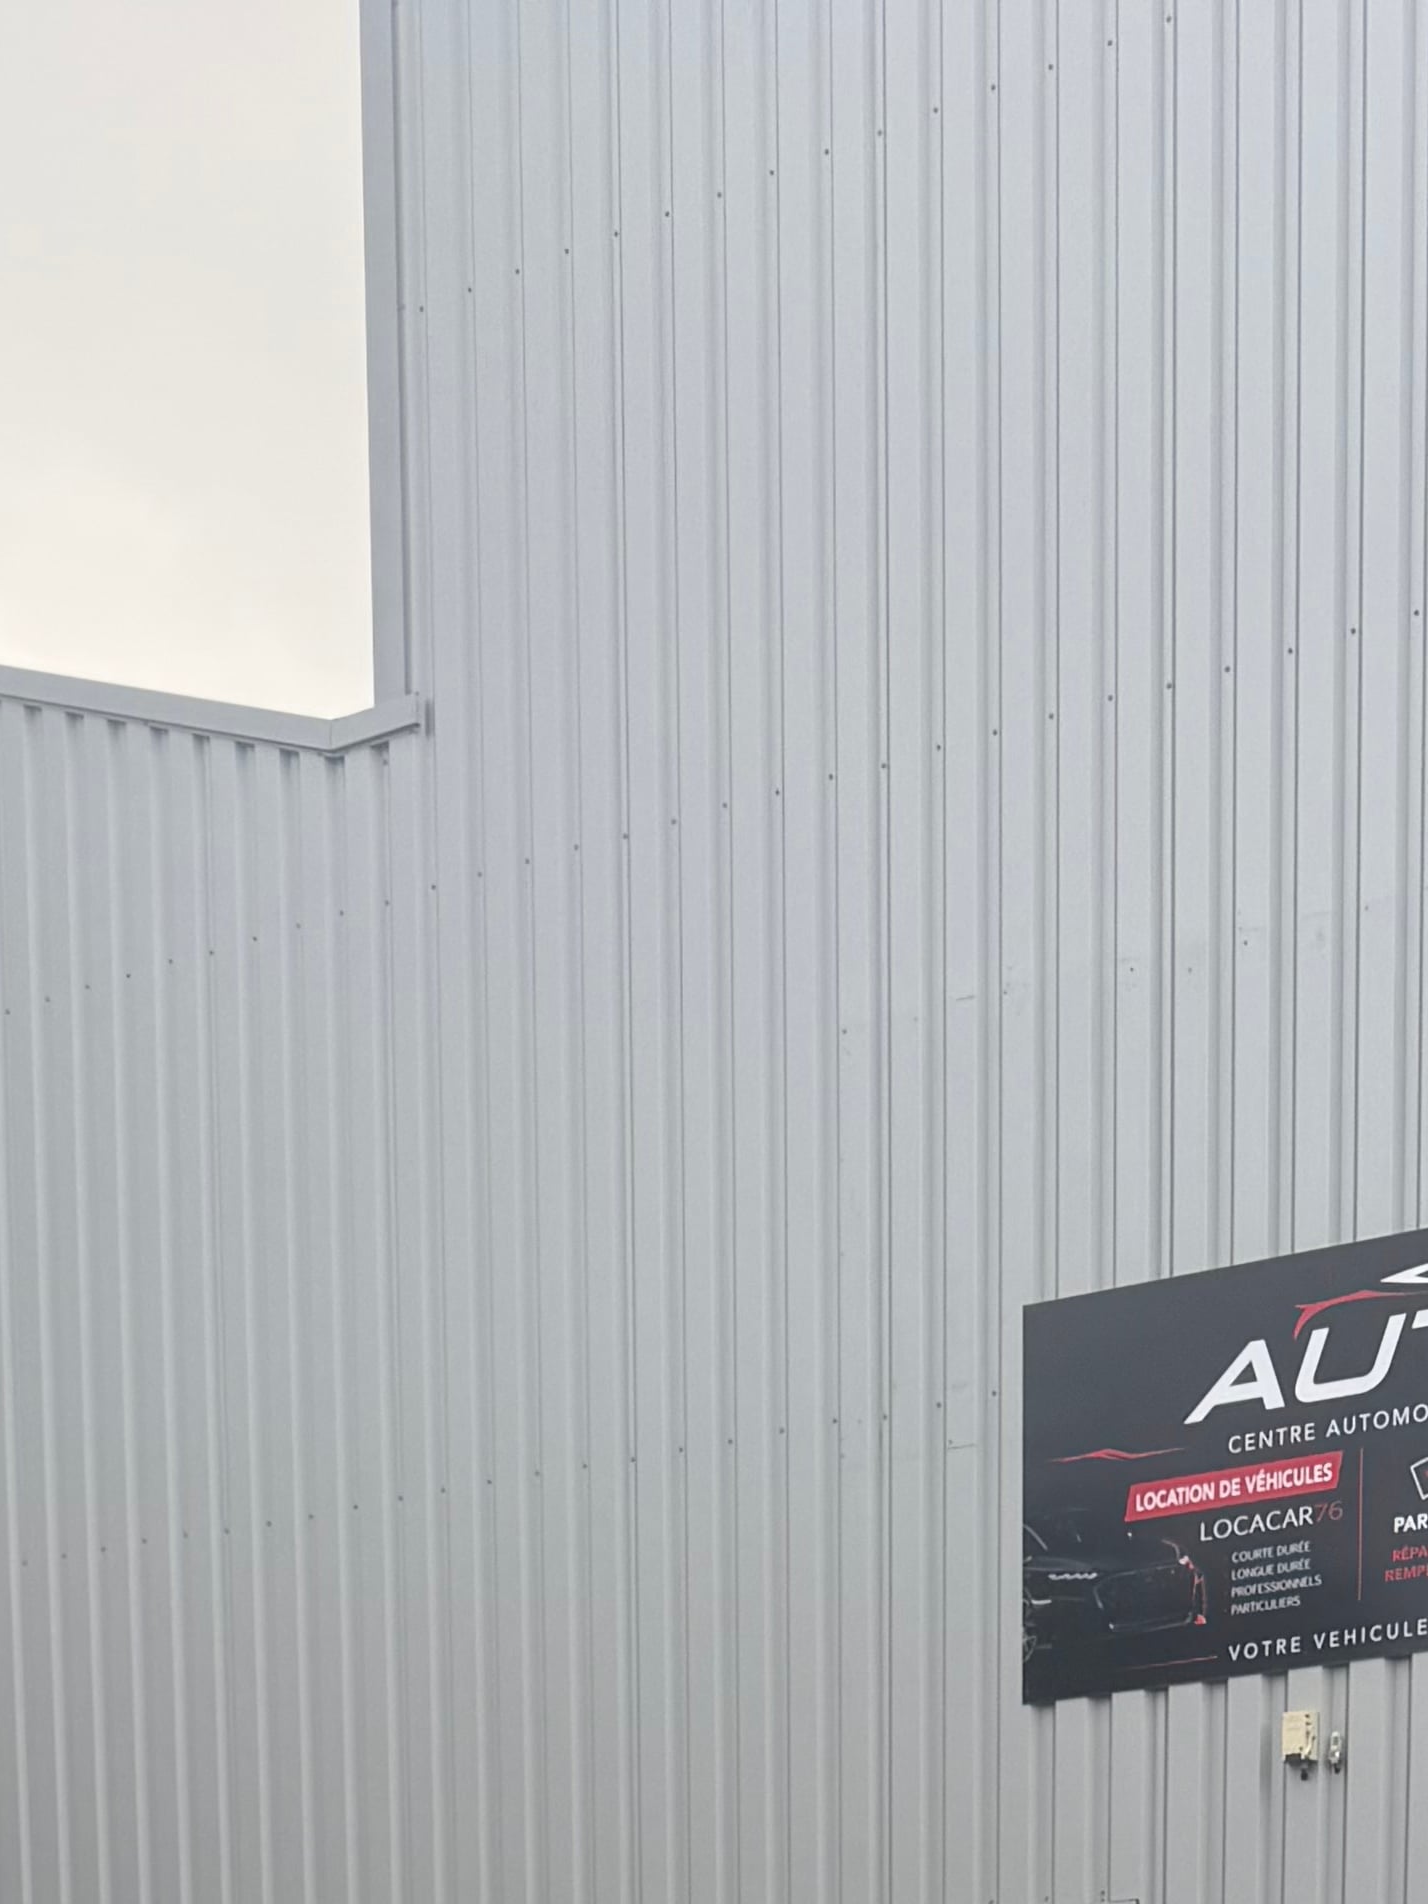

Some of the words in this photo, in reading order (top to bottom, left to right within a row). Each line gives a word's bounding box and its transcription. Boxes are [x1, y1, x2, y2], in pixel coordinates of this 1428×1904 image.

[1228, 1424, 1316, 1454] CENTRE
[1135, 1483, 1215, 1513] LOCATION
[1219, 1477, 1242, 1497] DE
[1244, 1462, 1333, 1494] VÉHICULES
[1200, 1500, 1344, 1542] LOCACAR76
[1231, 1546, 1274, 1563] COURTE
[1276, 1540, 1311, 1558] DURÉE
[1231, 1564, 1274, 1581] LONGUE
[1277, 1558, 1311, 1576] DURÉE
[1231, 1574, 1322, 1598] PROFESSIONNELS
[1231, 1596, 1301, 1616] PARTICULIERS
[1228, 1635, 1302, 1662] VOTRE
